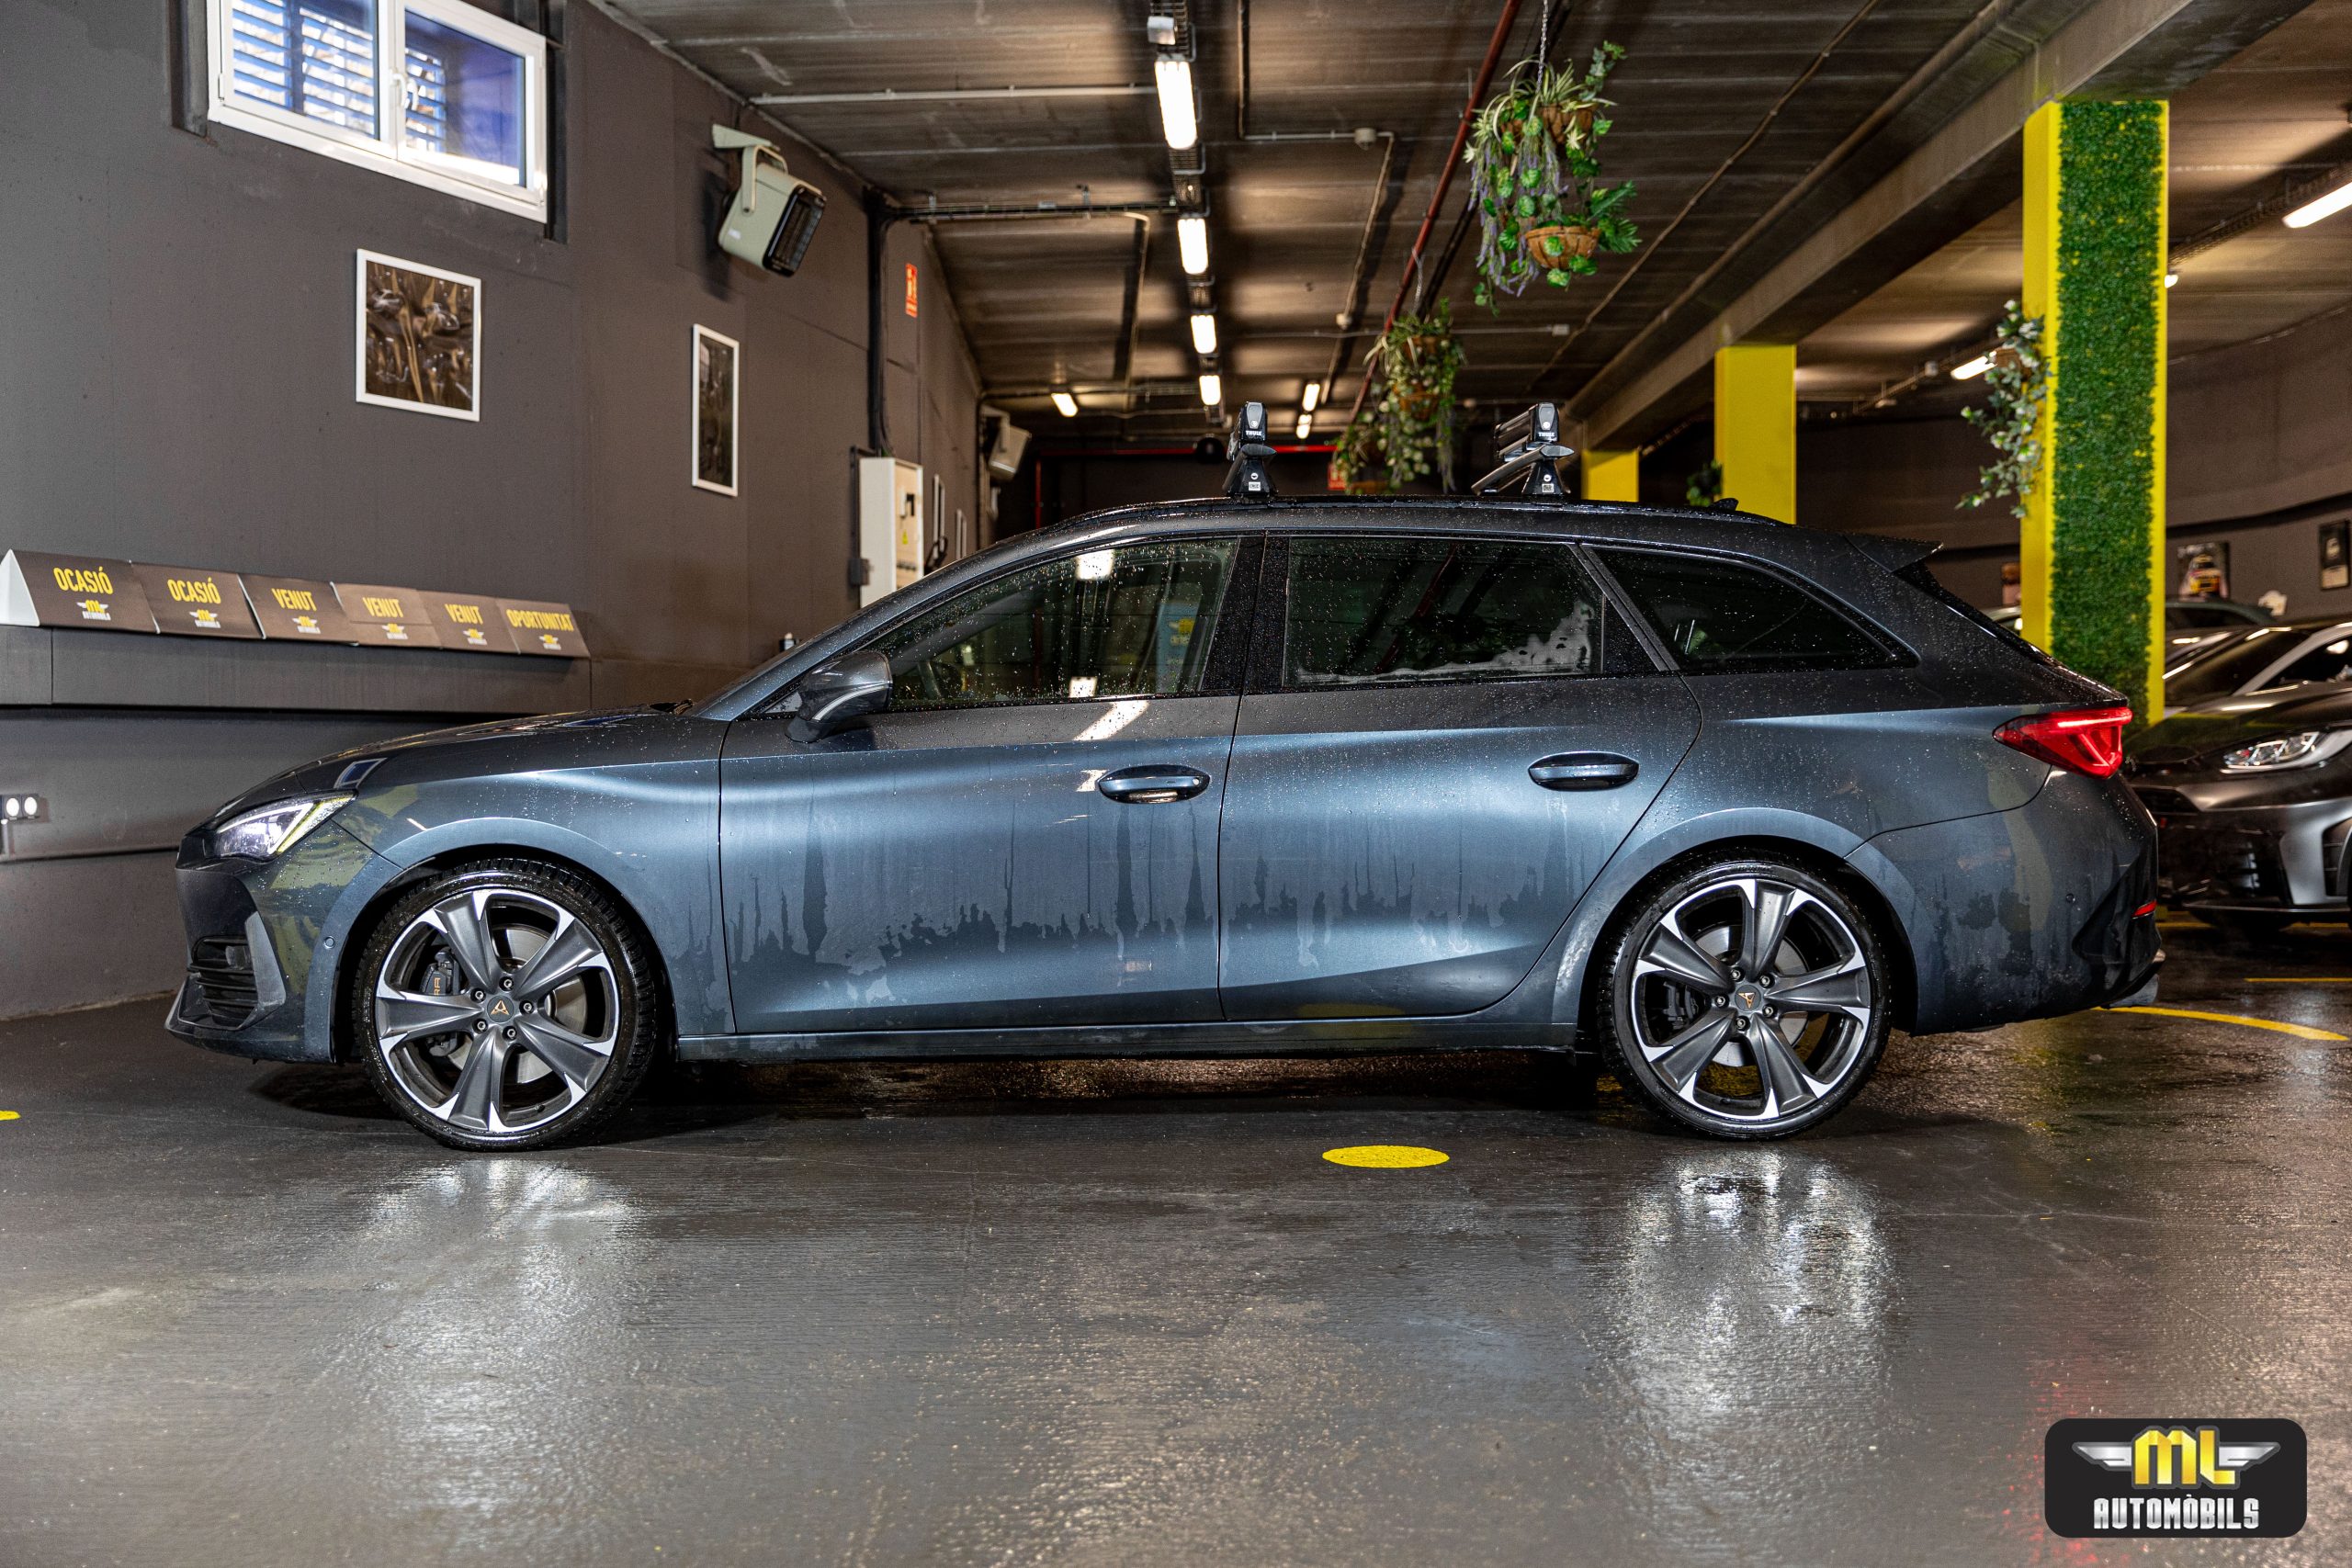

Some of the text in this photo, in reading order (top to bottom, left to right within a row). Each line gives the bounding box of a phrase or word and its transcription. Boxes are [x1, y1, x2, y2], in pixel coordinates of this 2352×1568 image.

[53, 566, 114, 595] OCASIÓ
[167, 577, 221, 604] OCASIÓ
[271, 588, 317, 612] VENUT
[362, 597, 403, 618] VENUT
[445, 604, 484, 625] VENUT
[506, 609, 574, 632] OPORTUNITAT
